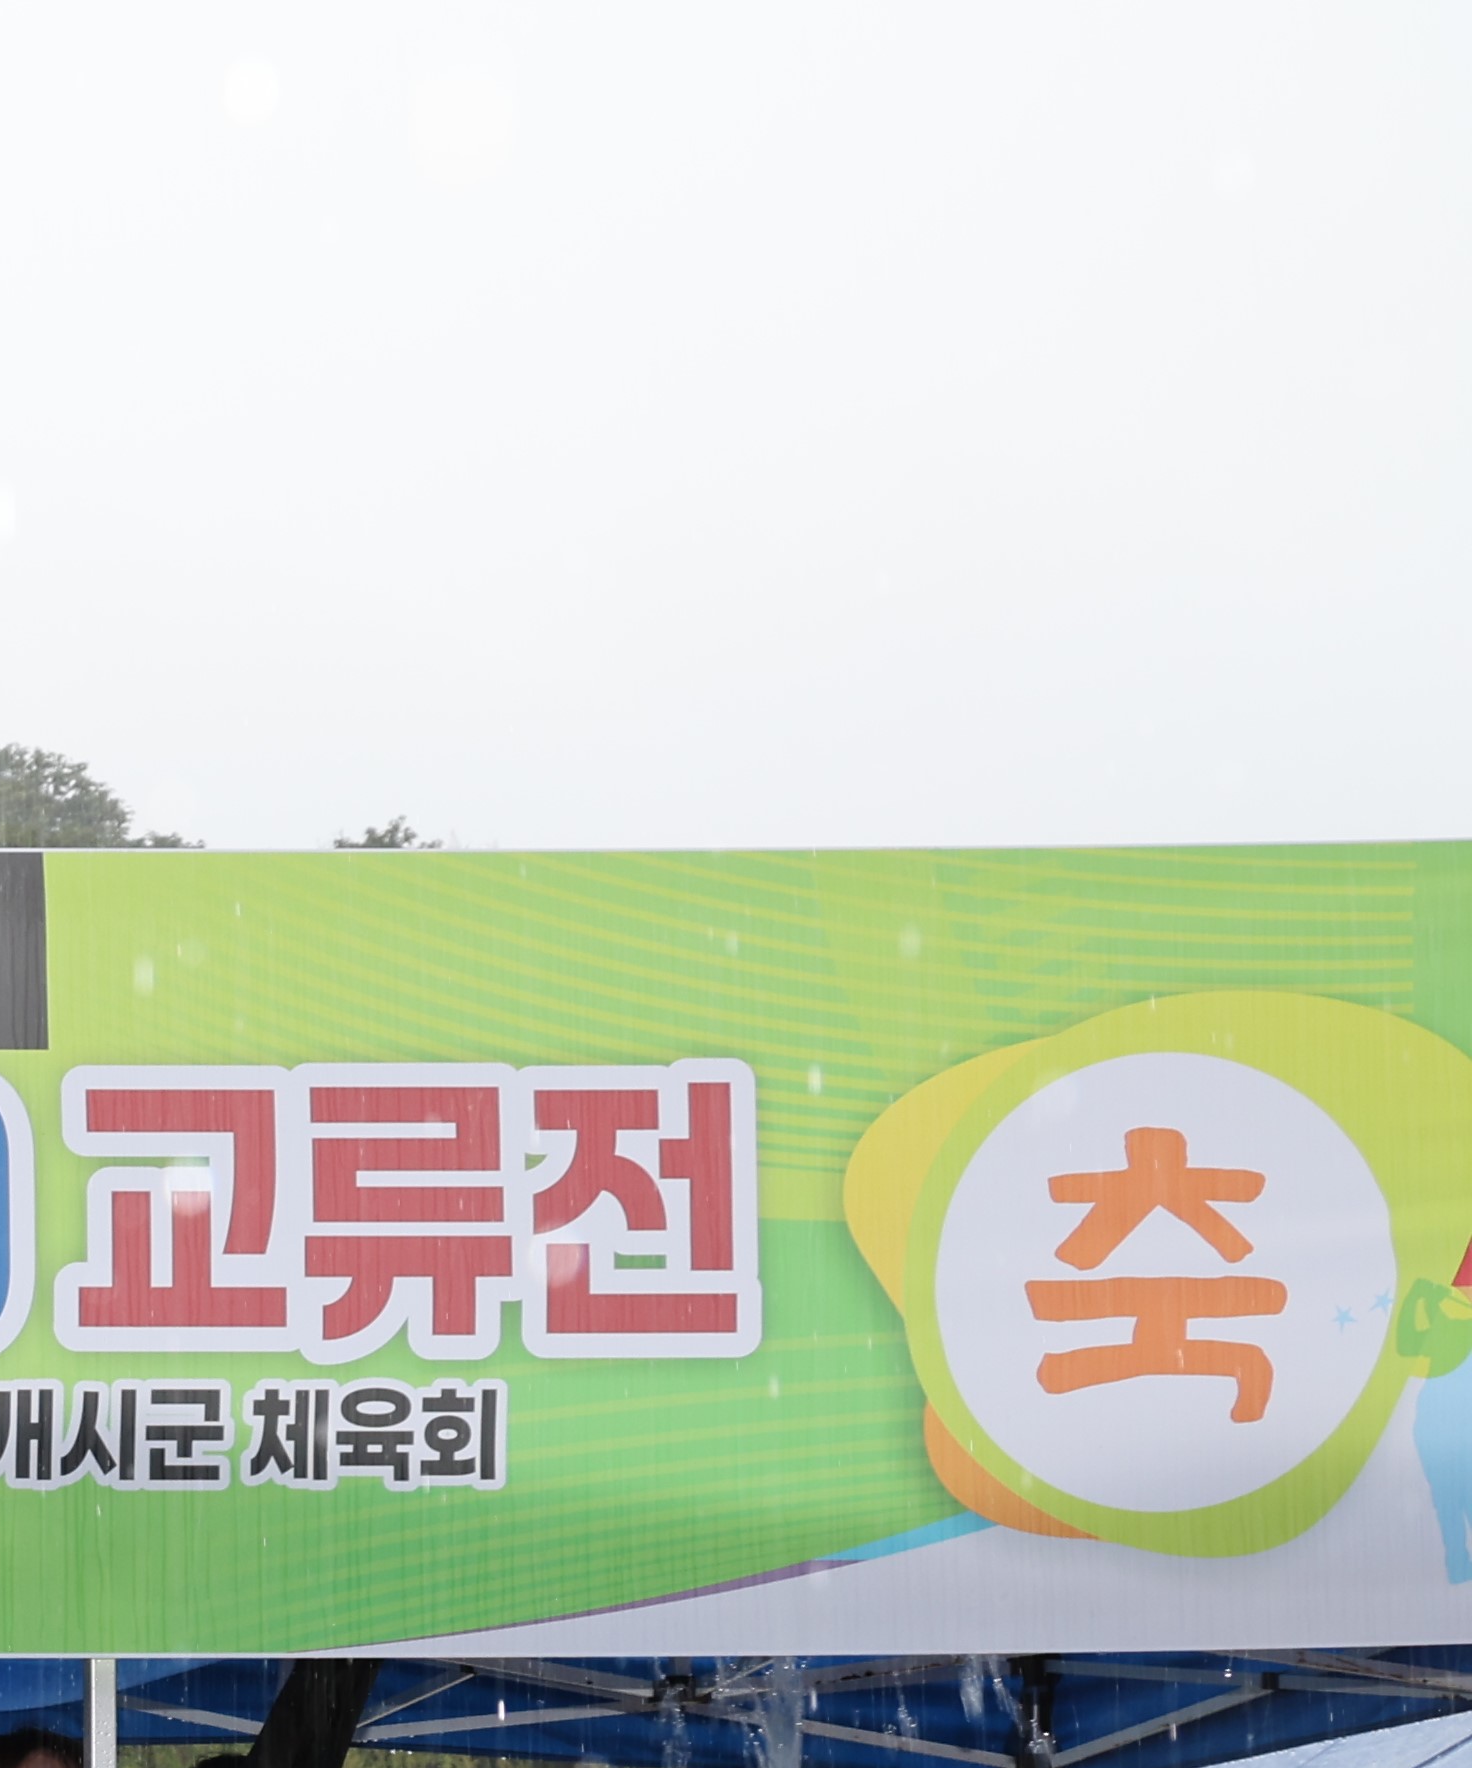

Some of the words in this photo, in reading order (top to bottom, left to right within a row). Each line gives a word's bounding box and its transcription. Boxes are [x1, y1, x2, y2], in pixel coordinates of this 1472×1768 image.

[78, 1082, 737, 1339] 교류전
[1024, 1127, 1288, 1423] 축
[248, 1388, 499, 1483] 체육회
